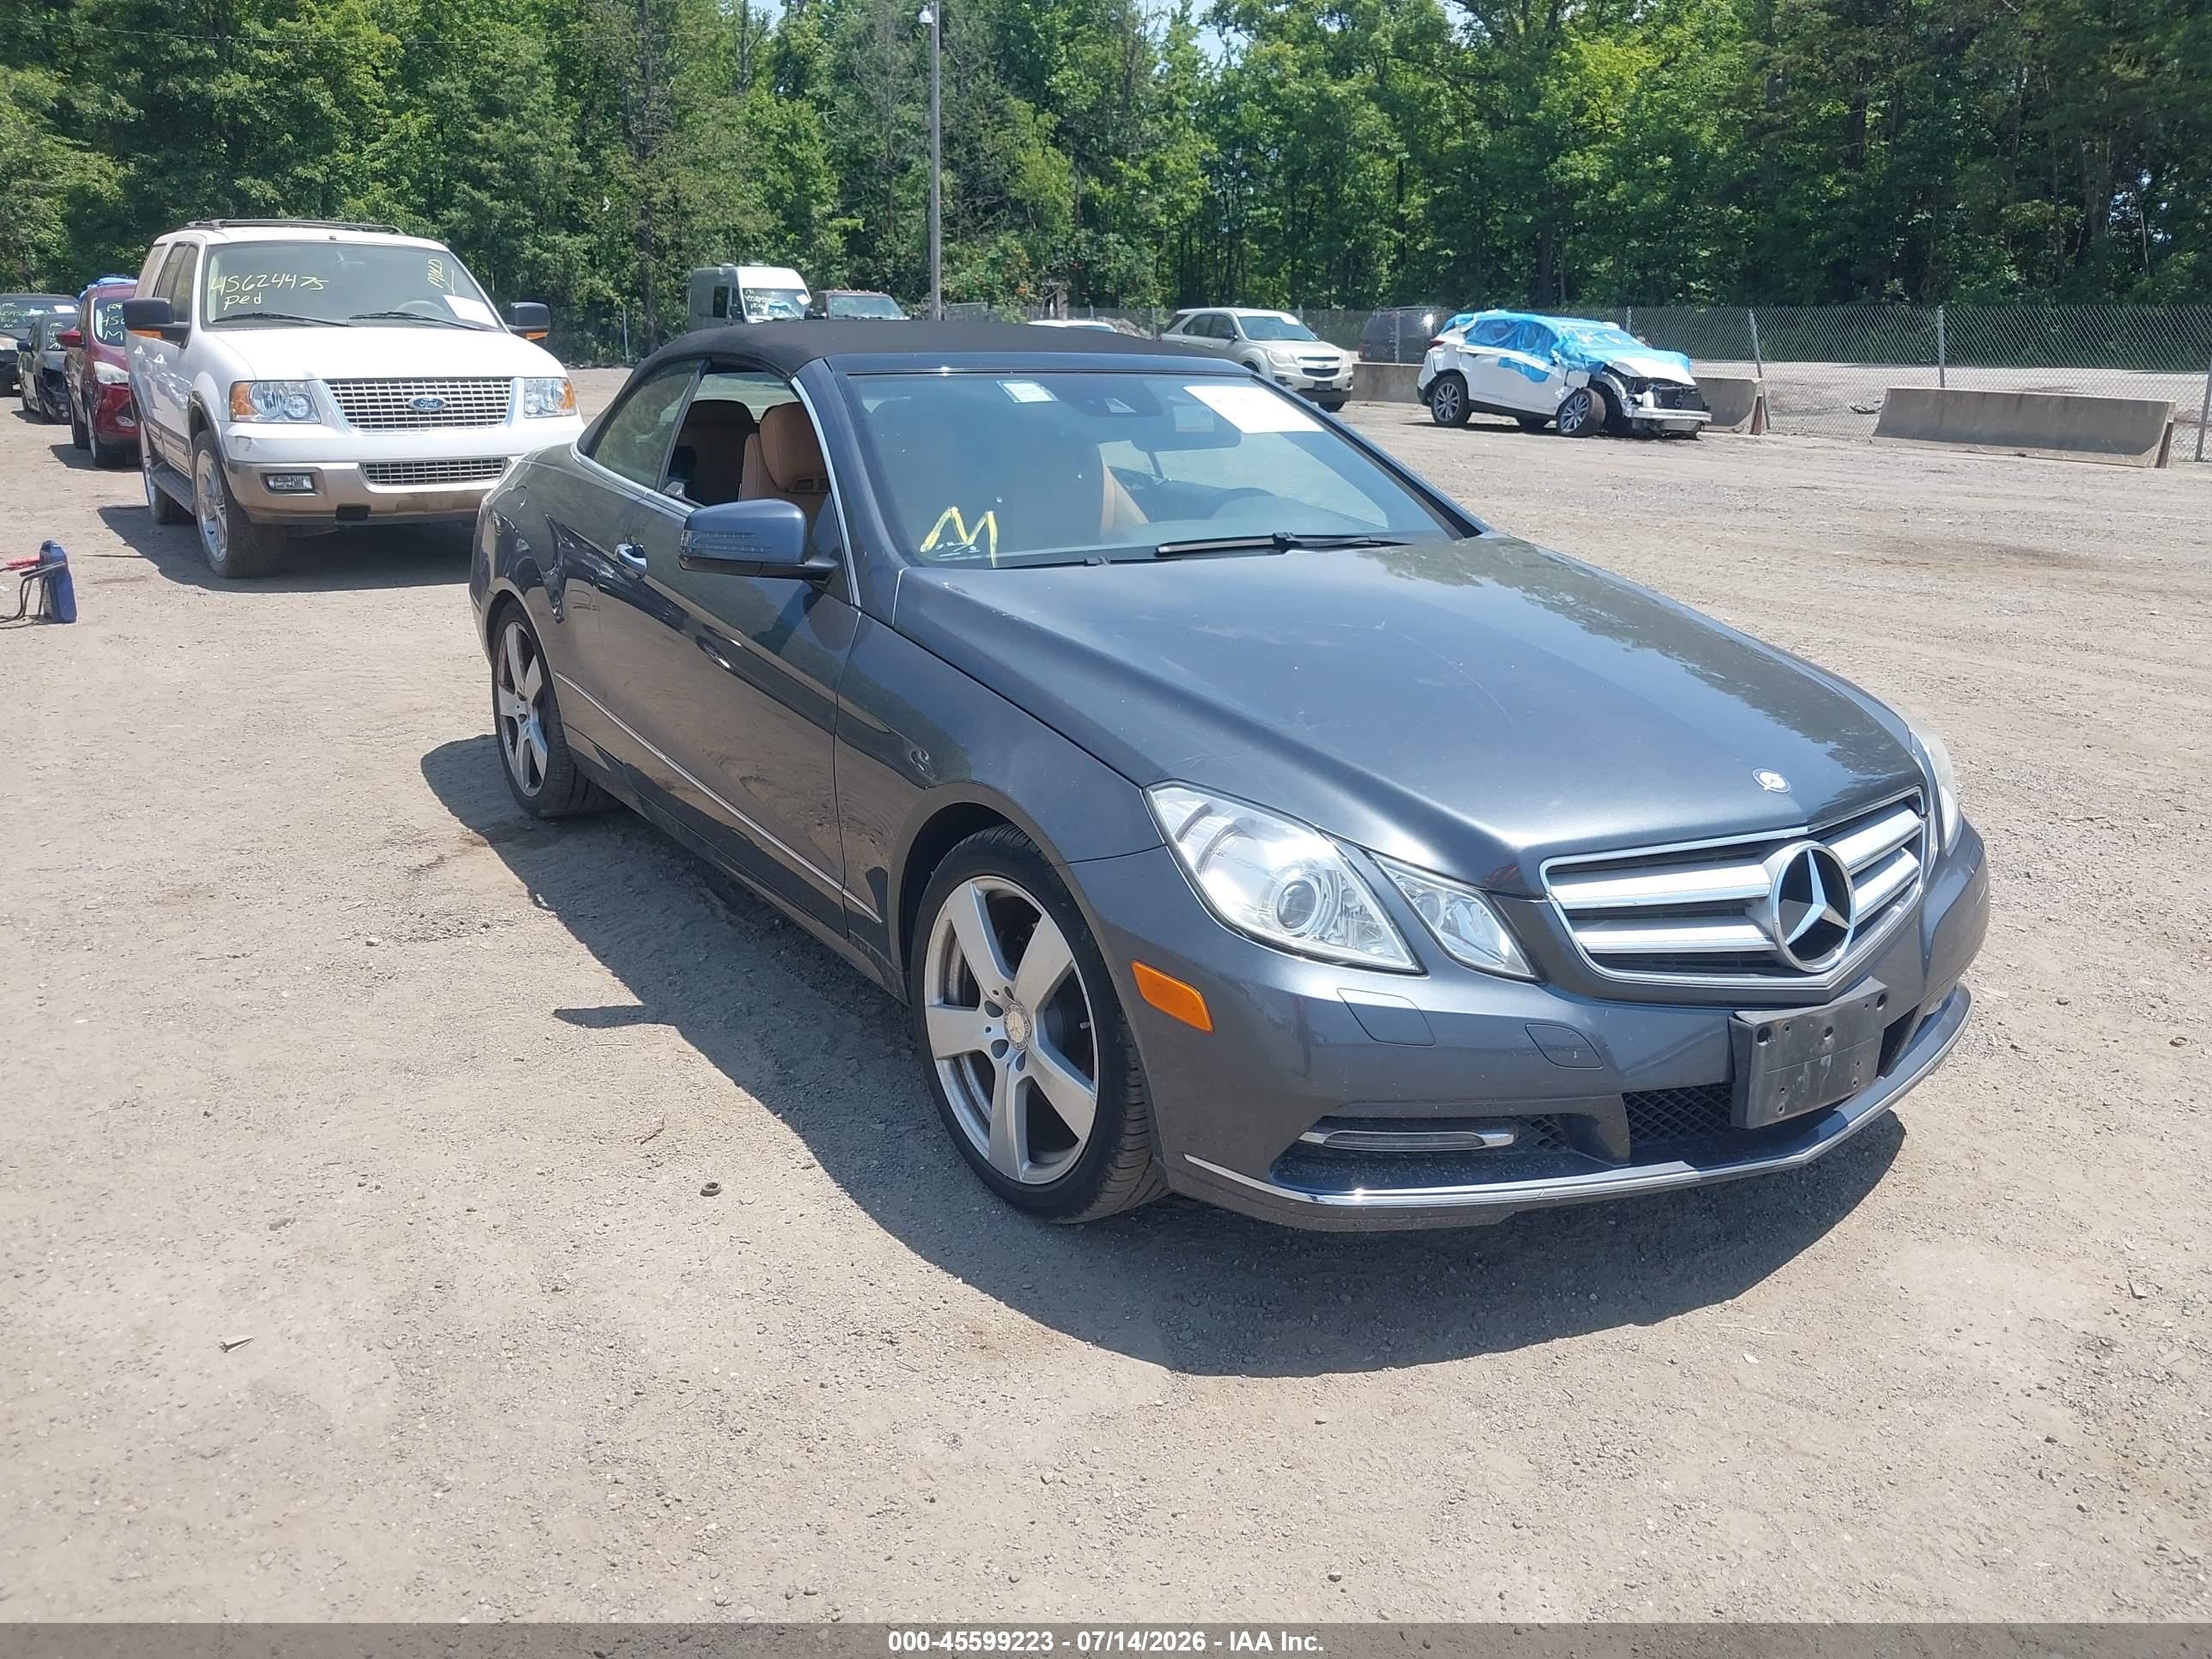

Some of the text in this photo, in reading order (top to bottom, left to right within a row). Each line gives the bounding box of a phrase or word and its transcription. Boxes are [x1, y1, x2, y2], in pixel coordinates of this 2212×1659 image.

[210, 273, 330, 295] 45624475
[104, 330, 124, 341] M
[418, 398, 440, 408] Ford
[920, 506, 998, 568] M
